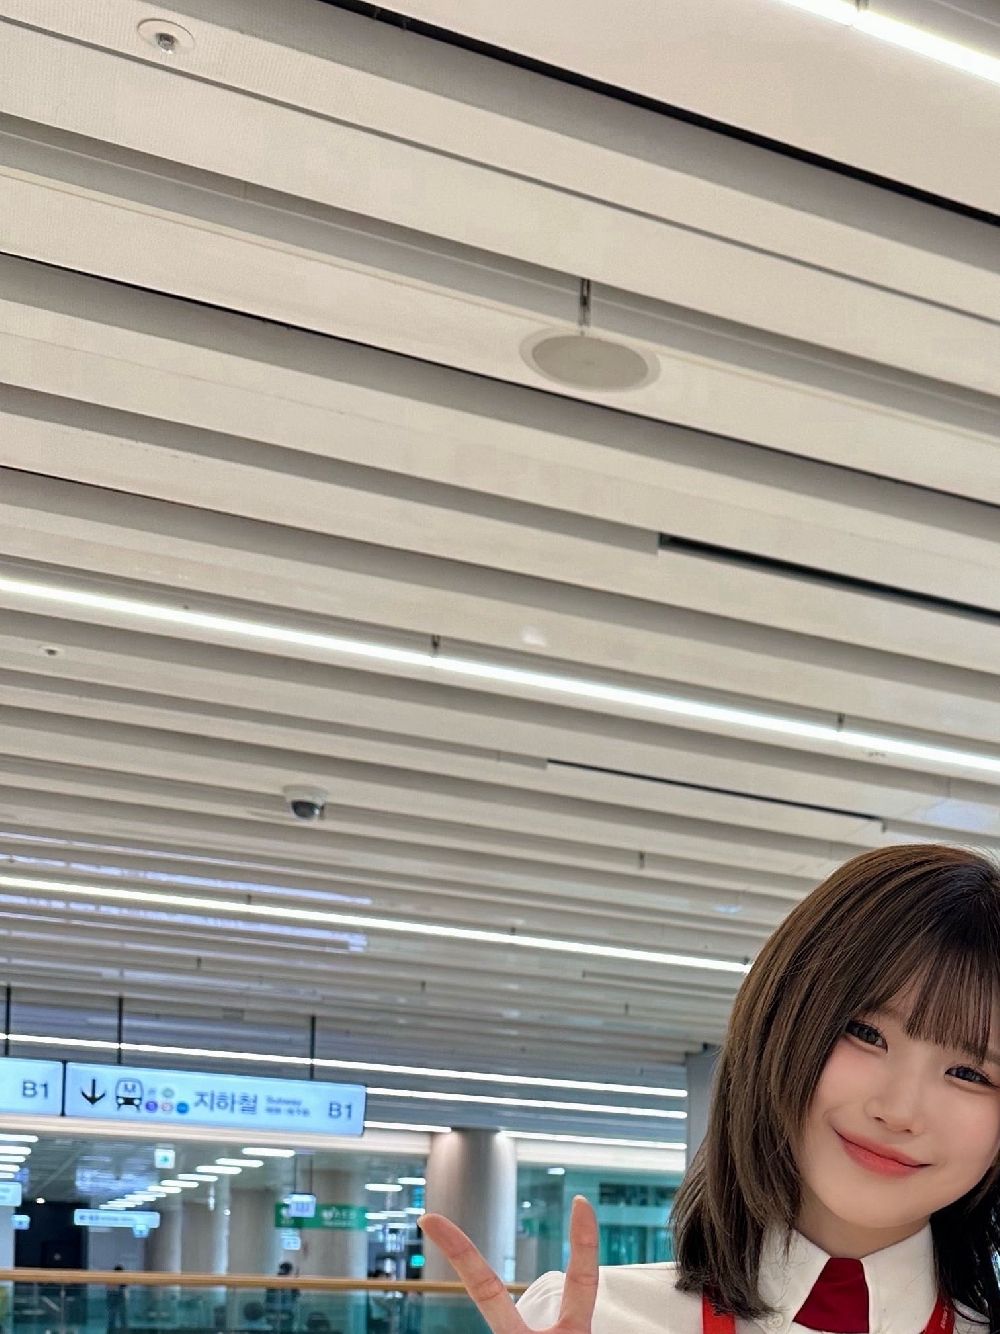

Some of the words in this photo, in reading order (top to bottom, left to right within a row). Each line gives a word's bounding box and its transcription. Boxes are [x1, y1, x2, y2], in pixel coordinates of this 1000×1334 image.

[22, 1079, 49, 1099] B1
[193, 1089, 258, 1115] 지하철
[327, 1101, 354, 1120] B1
